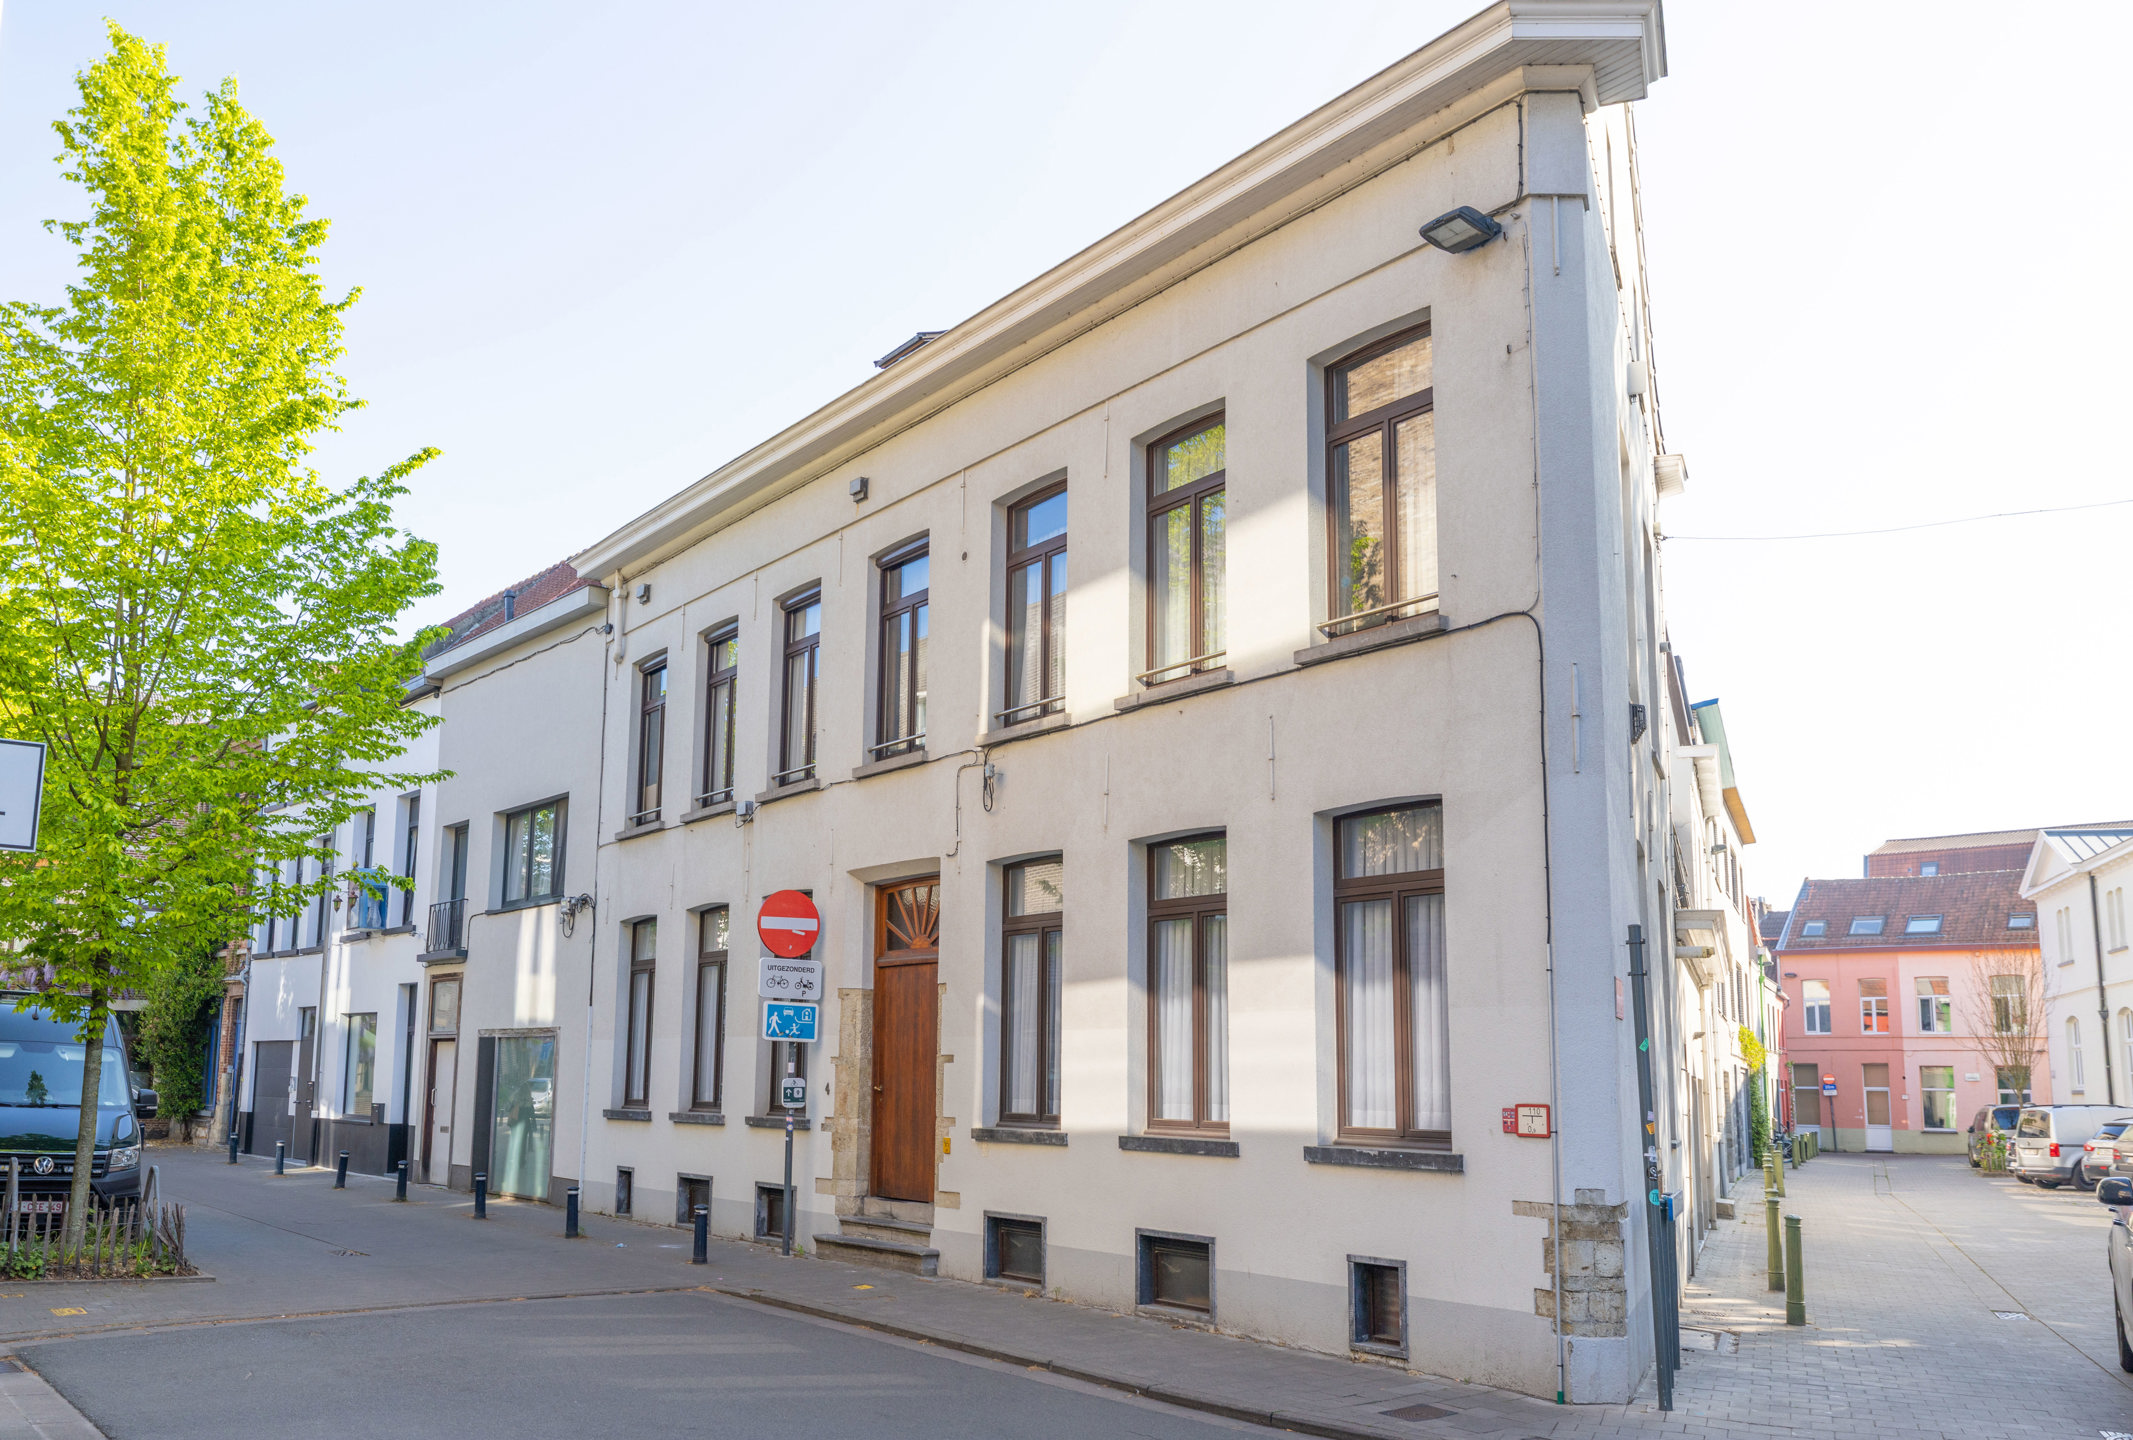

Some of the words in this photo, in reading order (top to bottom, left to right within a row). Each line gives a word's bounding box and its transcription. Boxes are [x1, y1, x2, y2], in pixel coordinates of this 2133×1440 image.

[767, 964, 815, 974] UITGEZONDERD
[824, 1082, 831, 1096] 4
[1528, 1107, 1540, 1115] 110
